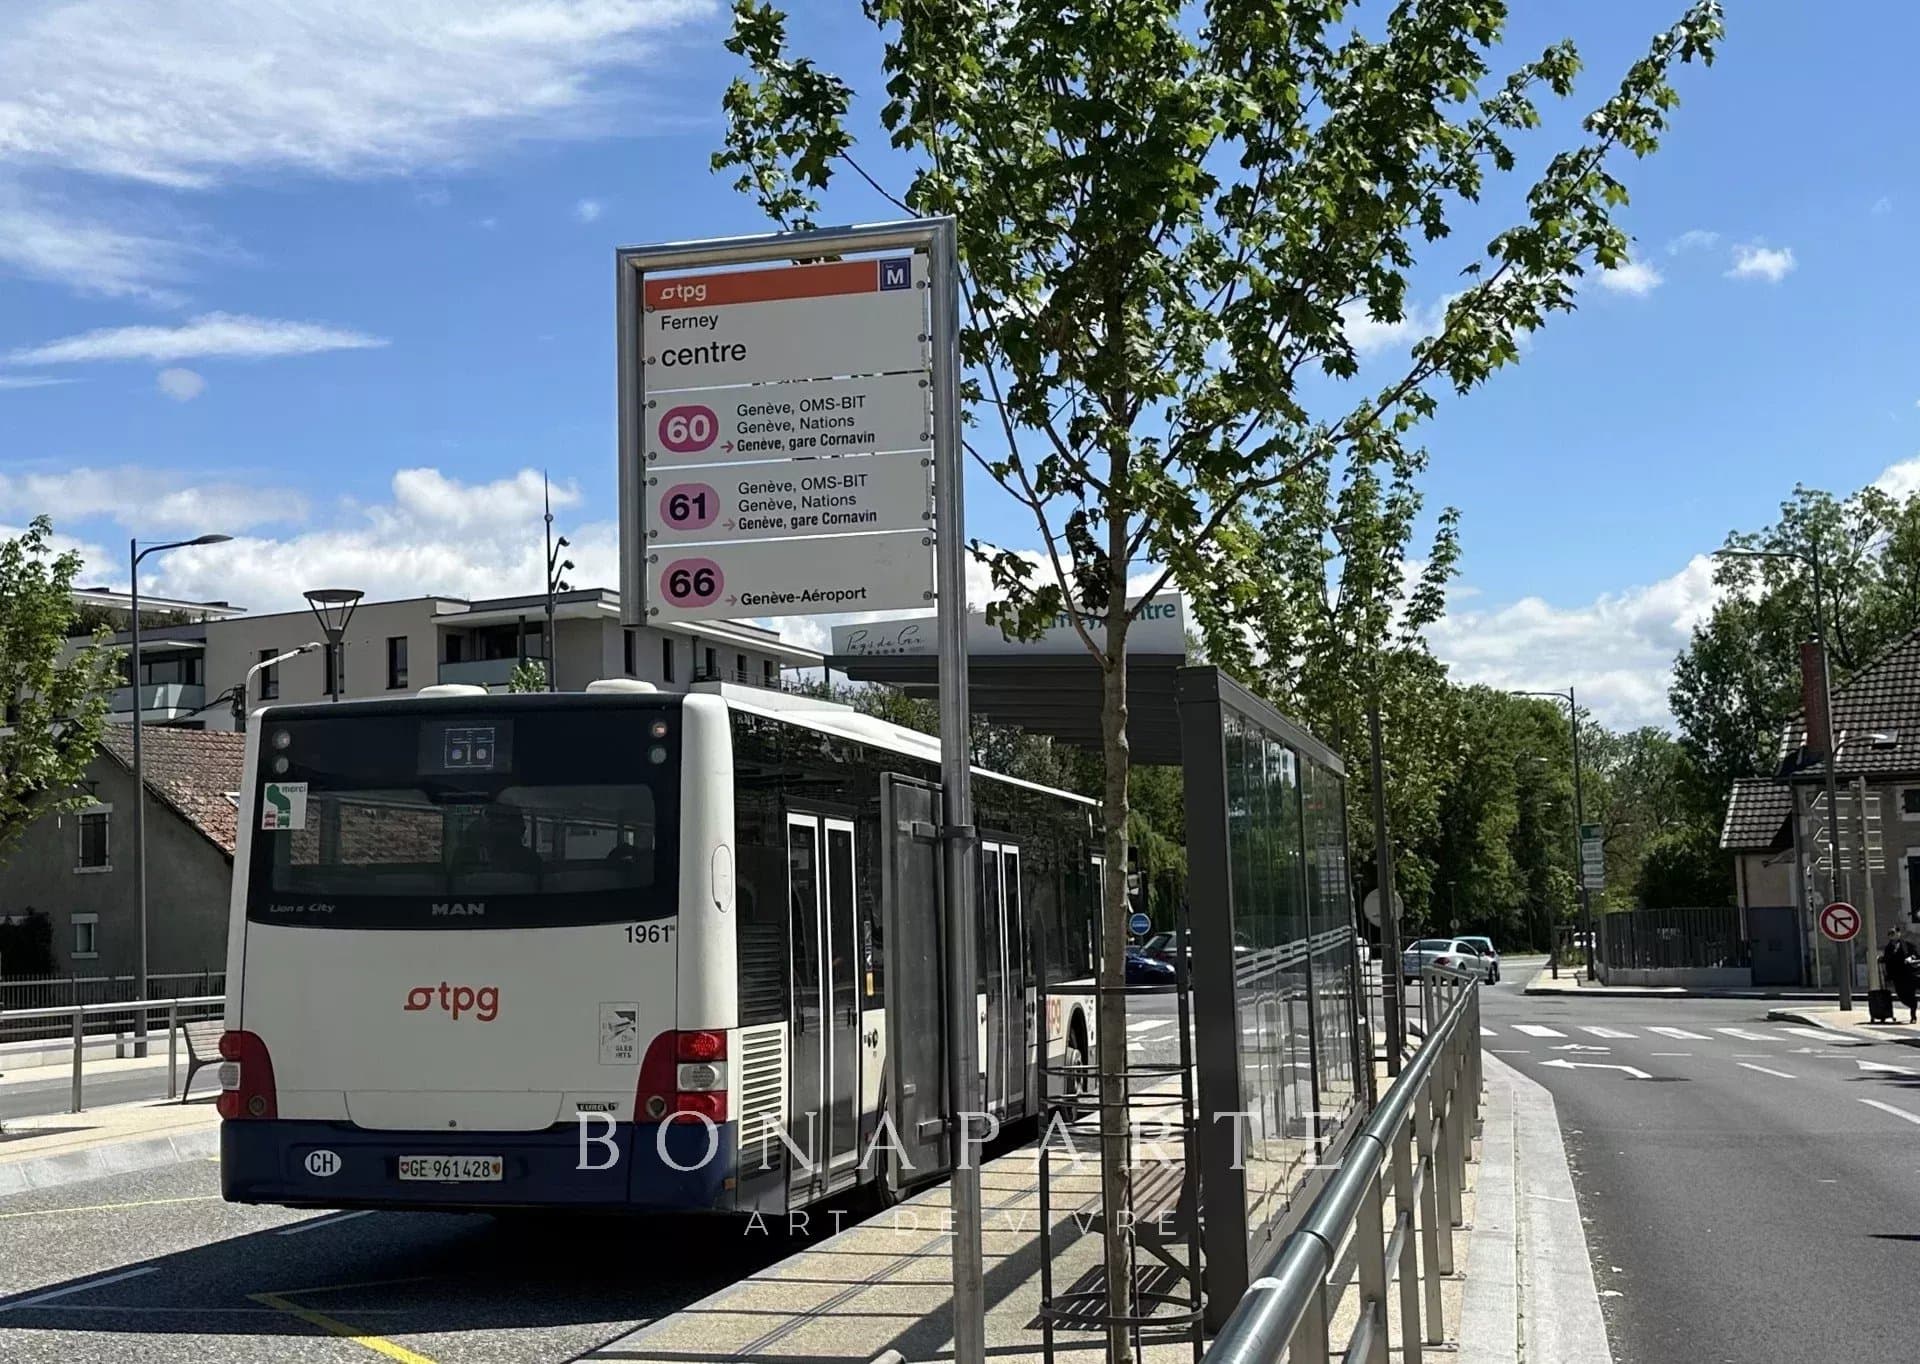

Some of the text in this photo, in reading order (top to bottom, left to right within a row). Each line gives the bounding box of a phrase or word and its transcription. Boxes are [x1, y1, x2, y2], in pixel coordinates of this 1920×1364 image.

[887, 268, 904, 285] M
[661, 314, 719, 331] Ferney
[661, 341, 747, 367] centre
[737, 395, 867, 417] Genève, OMS-BIT
[667, 414, 711, 444] 60
[737, 415, 855, 435] Genève, Nations
[737, 431, 876, 452] Genève, gare Cornavin
[738, 474, 868, 495] Genève, OMS-BIT
[669, 493, 707, 522] 61
[738, 495, 857, 513] Genève, Nations
[738, 510, 877, 531] Genève, gare Cornavin
[669, 568, 716, 598] 66
[741, 587, 867, 606] Genève-Aéroport
[282, 784, 307, 793] merci
[308, 903, 336, 913] City
[431, 903, 485, 915] MAN
[625, 925, 669, 943] 1961
[310, 1153, 334, 1173] CH
